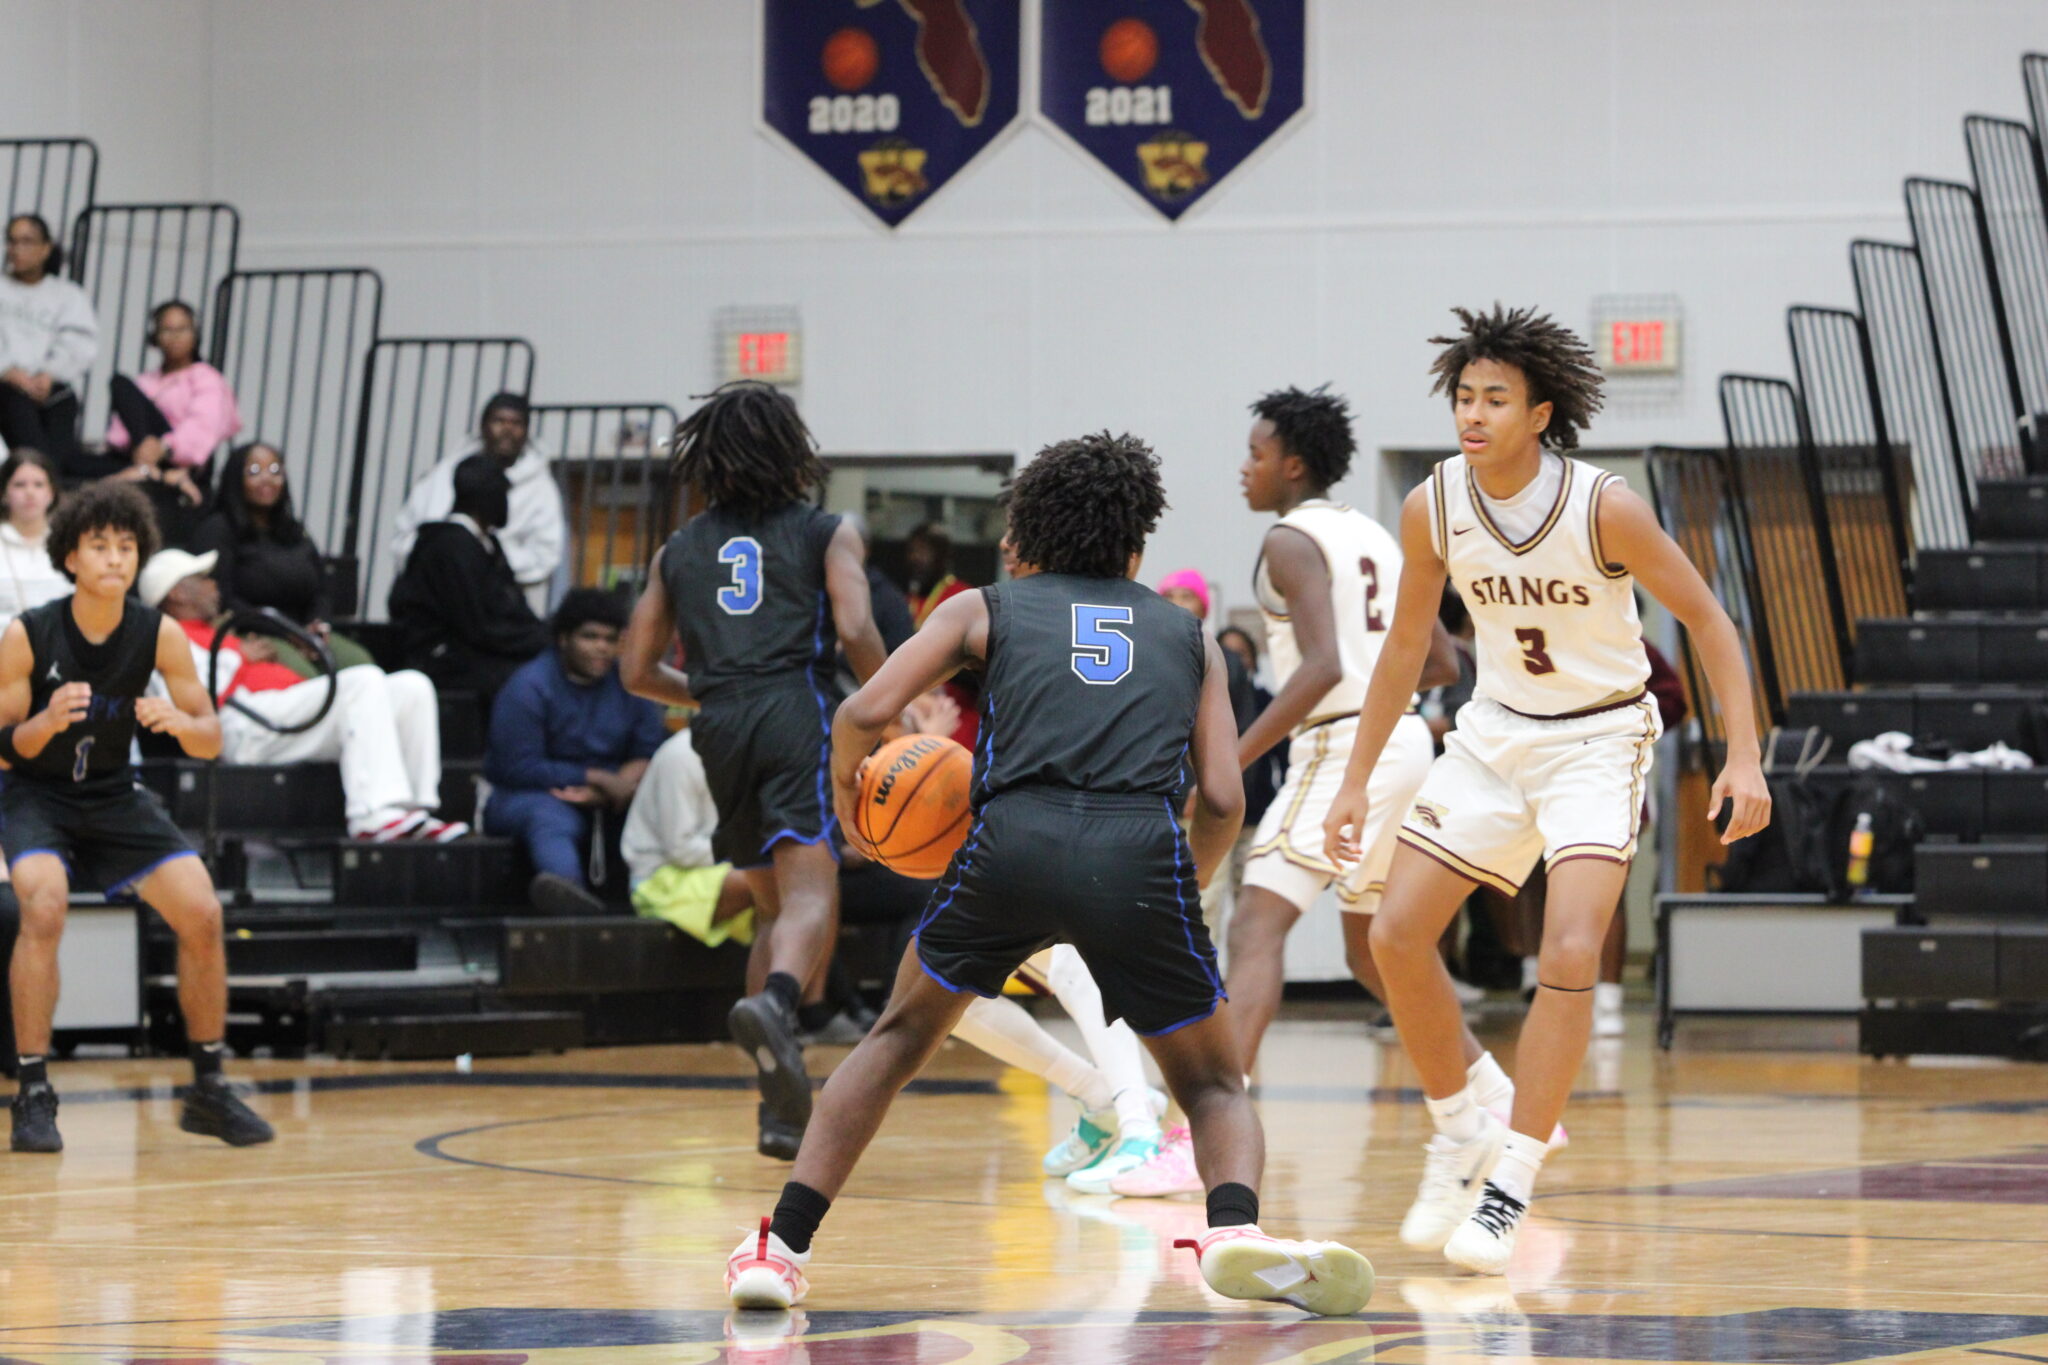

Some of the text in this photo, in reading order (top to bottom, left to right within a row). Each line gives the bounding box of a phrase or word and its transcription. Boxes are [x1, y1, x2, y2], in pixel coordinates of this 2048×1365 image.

[807, 93, 900, 134] 2020
[1085, 85, 1172, 126] 2021
[739, 332, 788, 375] EXIT
[1612, 321, 1664, 364] EXIT
[717, 536, 763, 615] 3
[1359, 556, 1387, 632] 2
[1471, 575, 1590, 606] STANGS
[1071, 603, 1134, 685] 5
[1514, 627, 1557, 676] 3
[873, 738, 944, 806] Wilson
